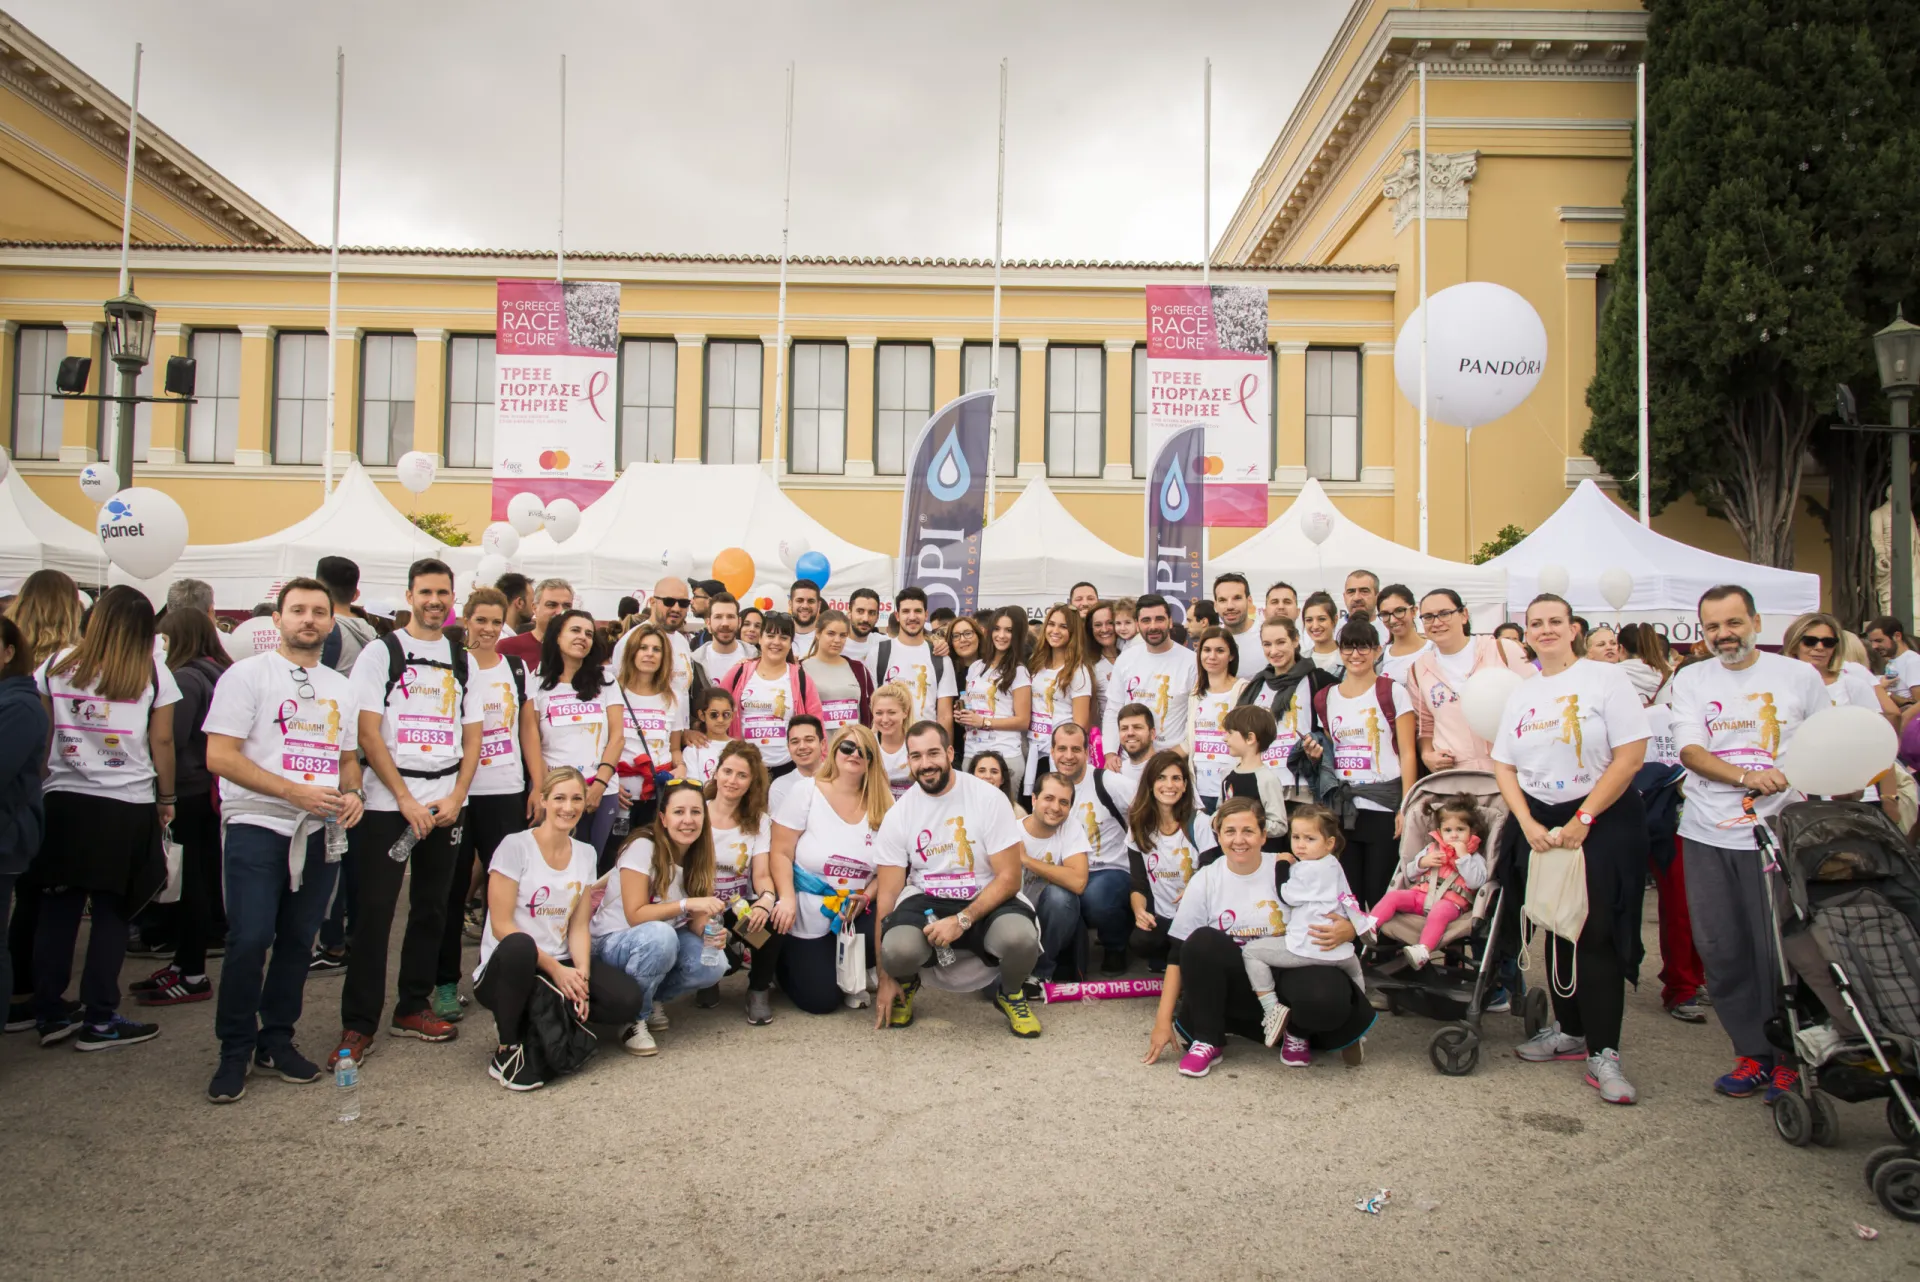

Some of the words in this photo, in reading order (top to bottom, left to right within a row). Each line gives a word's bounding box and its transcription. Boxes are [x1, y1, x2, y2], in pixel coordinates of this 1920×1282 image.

[515, 301, 560, 311] GREECE
[1164, 305, 1208, 316] GREECE
[503, 312, 560, 330] RACE
[1152, 317, 1208, 335] RACE
[514, 332, 556, 346] CURE
[1164, 336, 1205, 350] CURE
[501, 367, 552, 381] ΤΡΕΞΕ
[1151, 371, 1202, 385] ΤΡΕΞΕ
[499, 383, 581, 397] ΓΙΟΡΤΑΣΕ
[1151, 387, 1232, 401] ΓΙΟΡΤΑΣΕ
[499, 399, 568, 412] ΣΤΗΡΙΞΕ
[1151, 402, 1220, 417] ΣΤΗΡΙΞΕ
[82, 479, 101, 487] planet
[101, 523, 145, 543] planet
[483, 702, 501, 711] ΑΜΗ!
[557, 703, 595, 715] 16800
[829, 710, 854, 720] 18747
[288, 721, 324, 732] ΔΥΝΑΜΗ!
[1031, 723, 1048, 732] 868
[1522, 719, 1559, 732] ΔΥΝΑΜΗ!
[1712, 720, 1756, 731] ΔΥΝΑΜΗ!
[405, 729, 447, 743] 16833
[750, 728, 780, 737] 18742
[1198, 742, 1228, 753] 18730
[289, 756, 331, 773] 16832
[1336, 758, 1364, 769] 16863
[829, 866, 863, 877] 16894
[1081, 982, 1106, 995] FOR
[1108, 981, 1131, 993] THE
